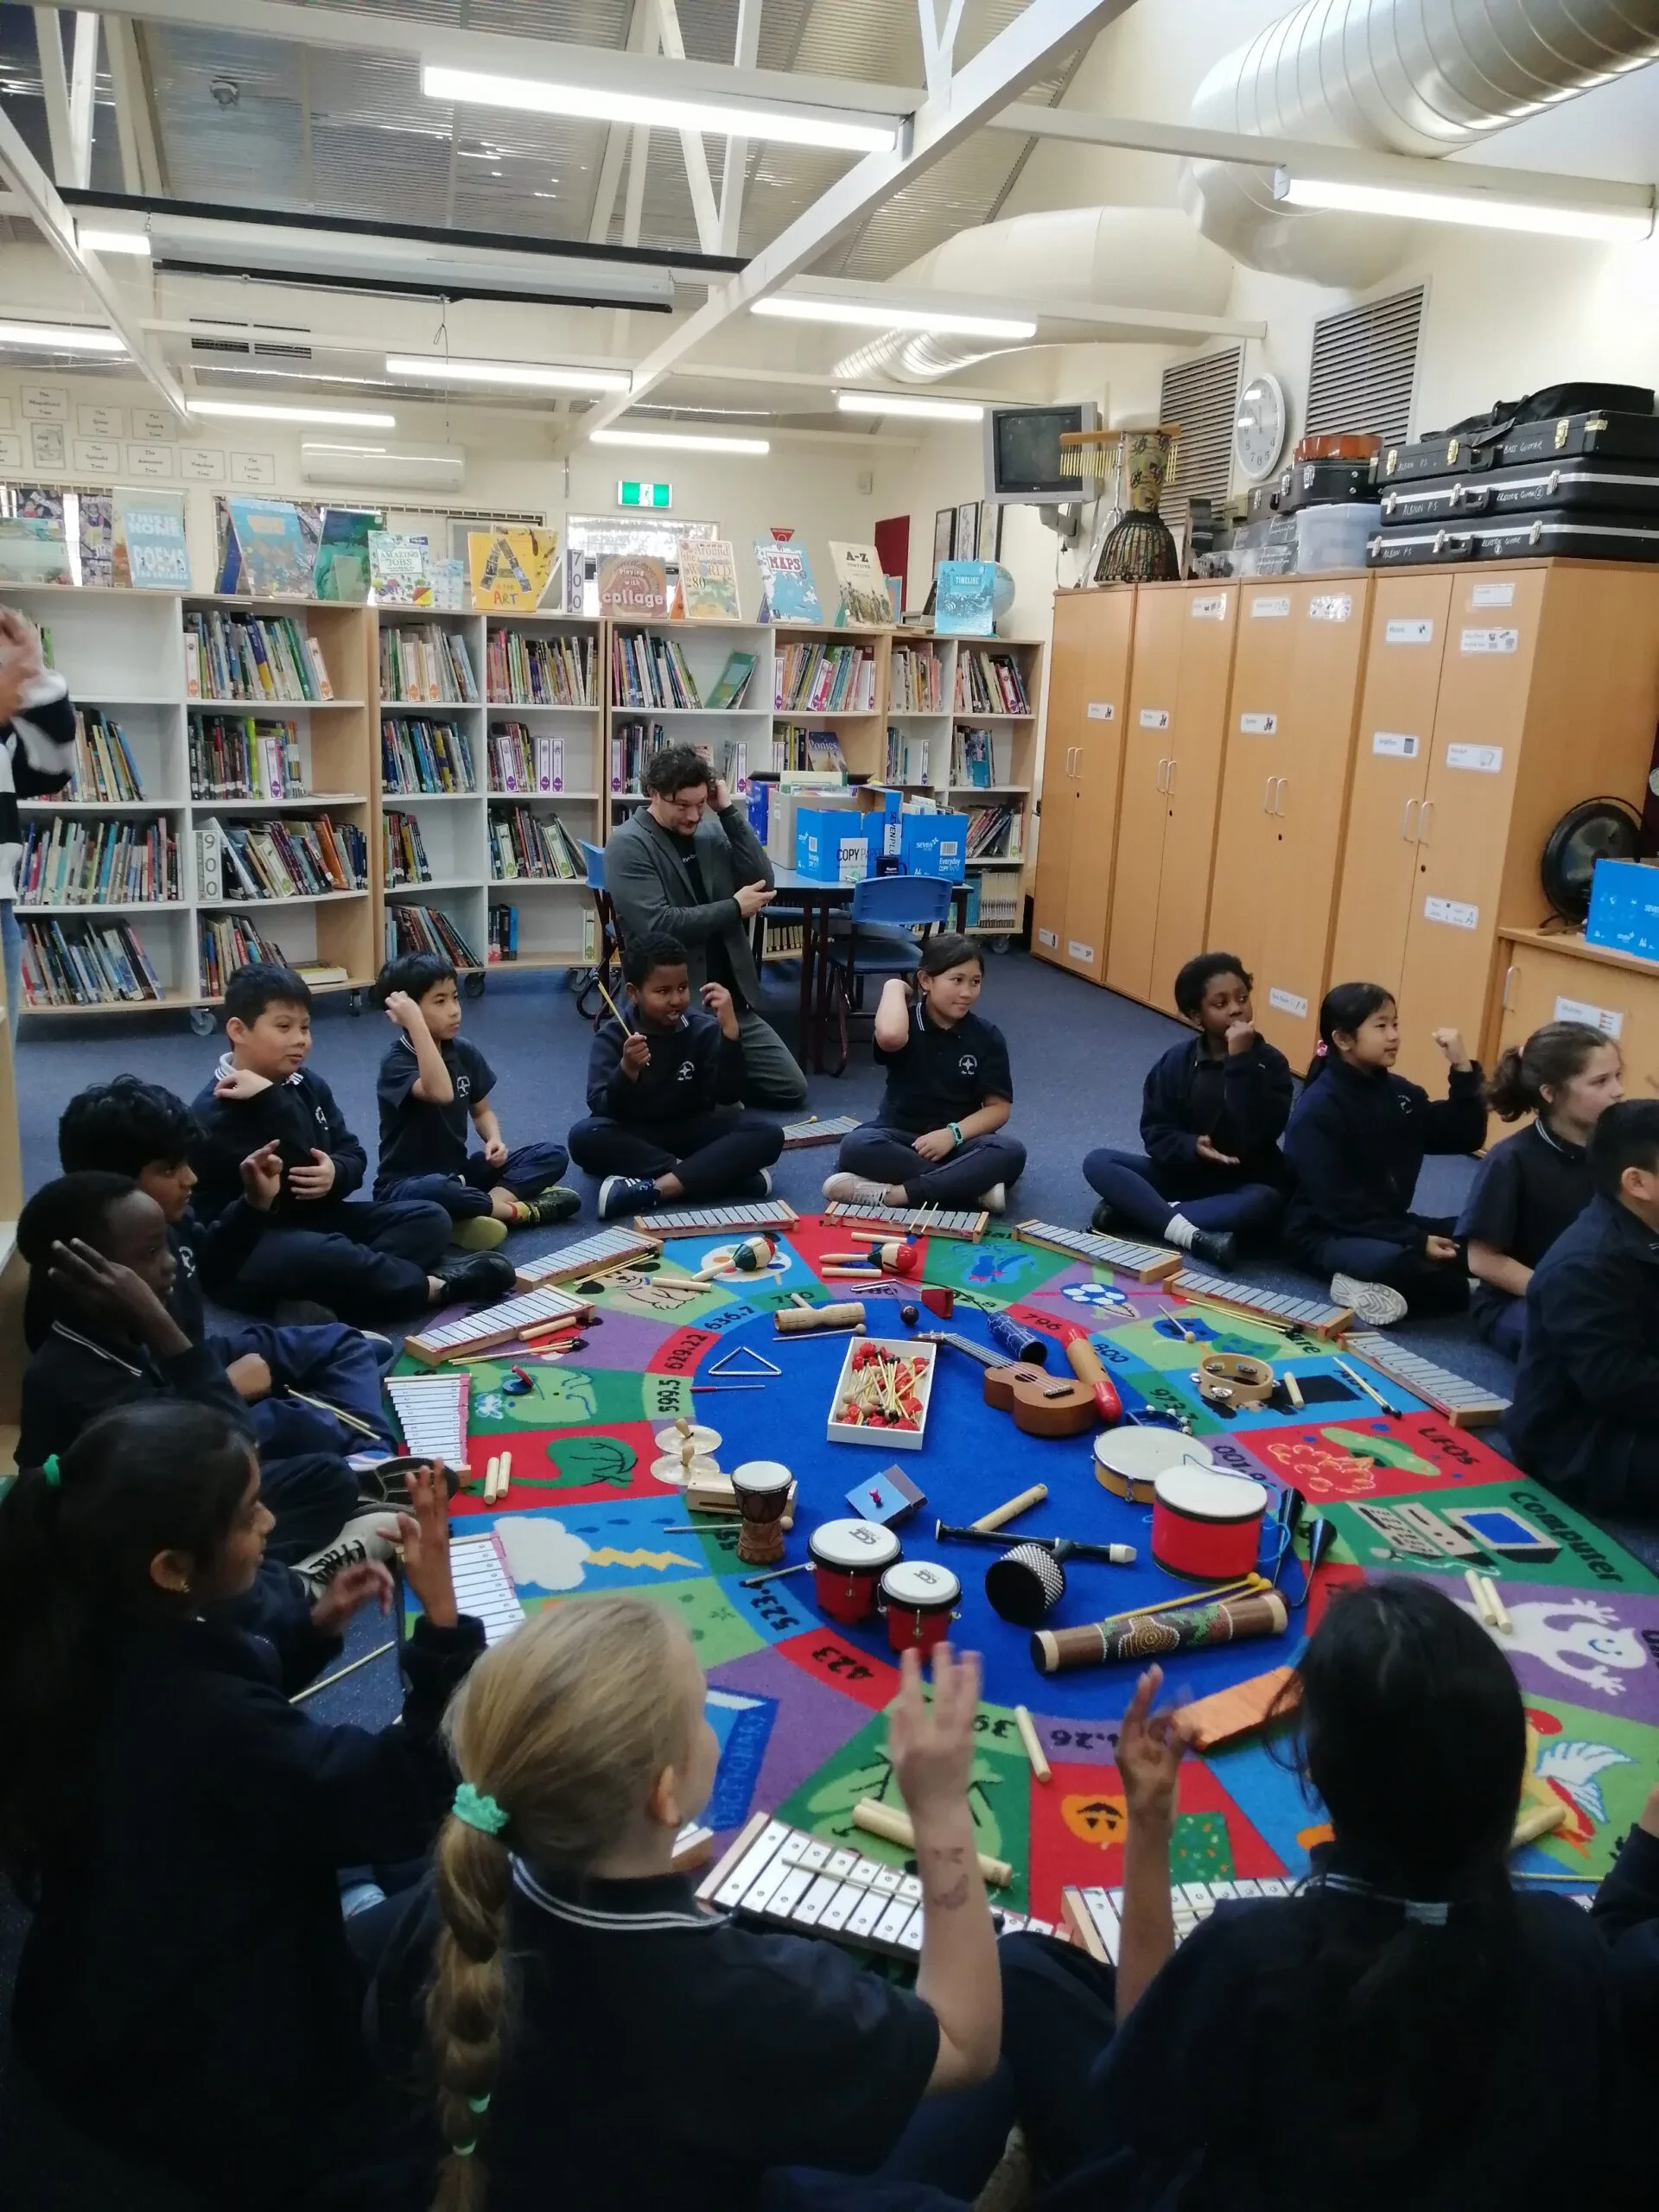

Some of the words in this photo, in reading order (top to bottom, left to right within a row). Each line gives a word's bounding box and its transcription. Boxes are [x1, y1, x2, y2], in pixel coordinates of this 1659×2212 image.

[695, 544, 729, 556] Around
[846, 550, 869, 563] A-Z
[768, 556, 803, 570] MAPS
[619, 568, 645, 577] Playing
[493, 591, 519, 606] ART
[601, 589, 664, 608] collage
[809, 740, 839, 751] Ponies
[836, 848, 860, 861] COPY
[939, 857, 961, 866] Everyday
[704, 1306, 756, 1331] 636.7
[664, 1334, 709, 1370] 629.22
[1092, 1343, 1130, 1363] 800
[657, 1379, 681, 1413] 599.5
[1418, 1427, 1481, 1465] UFOs
[1510, 1491, 1624, 1584] Computer
[812, 1645, 874, 1681] 423
